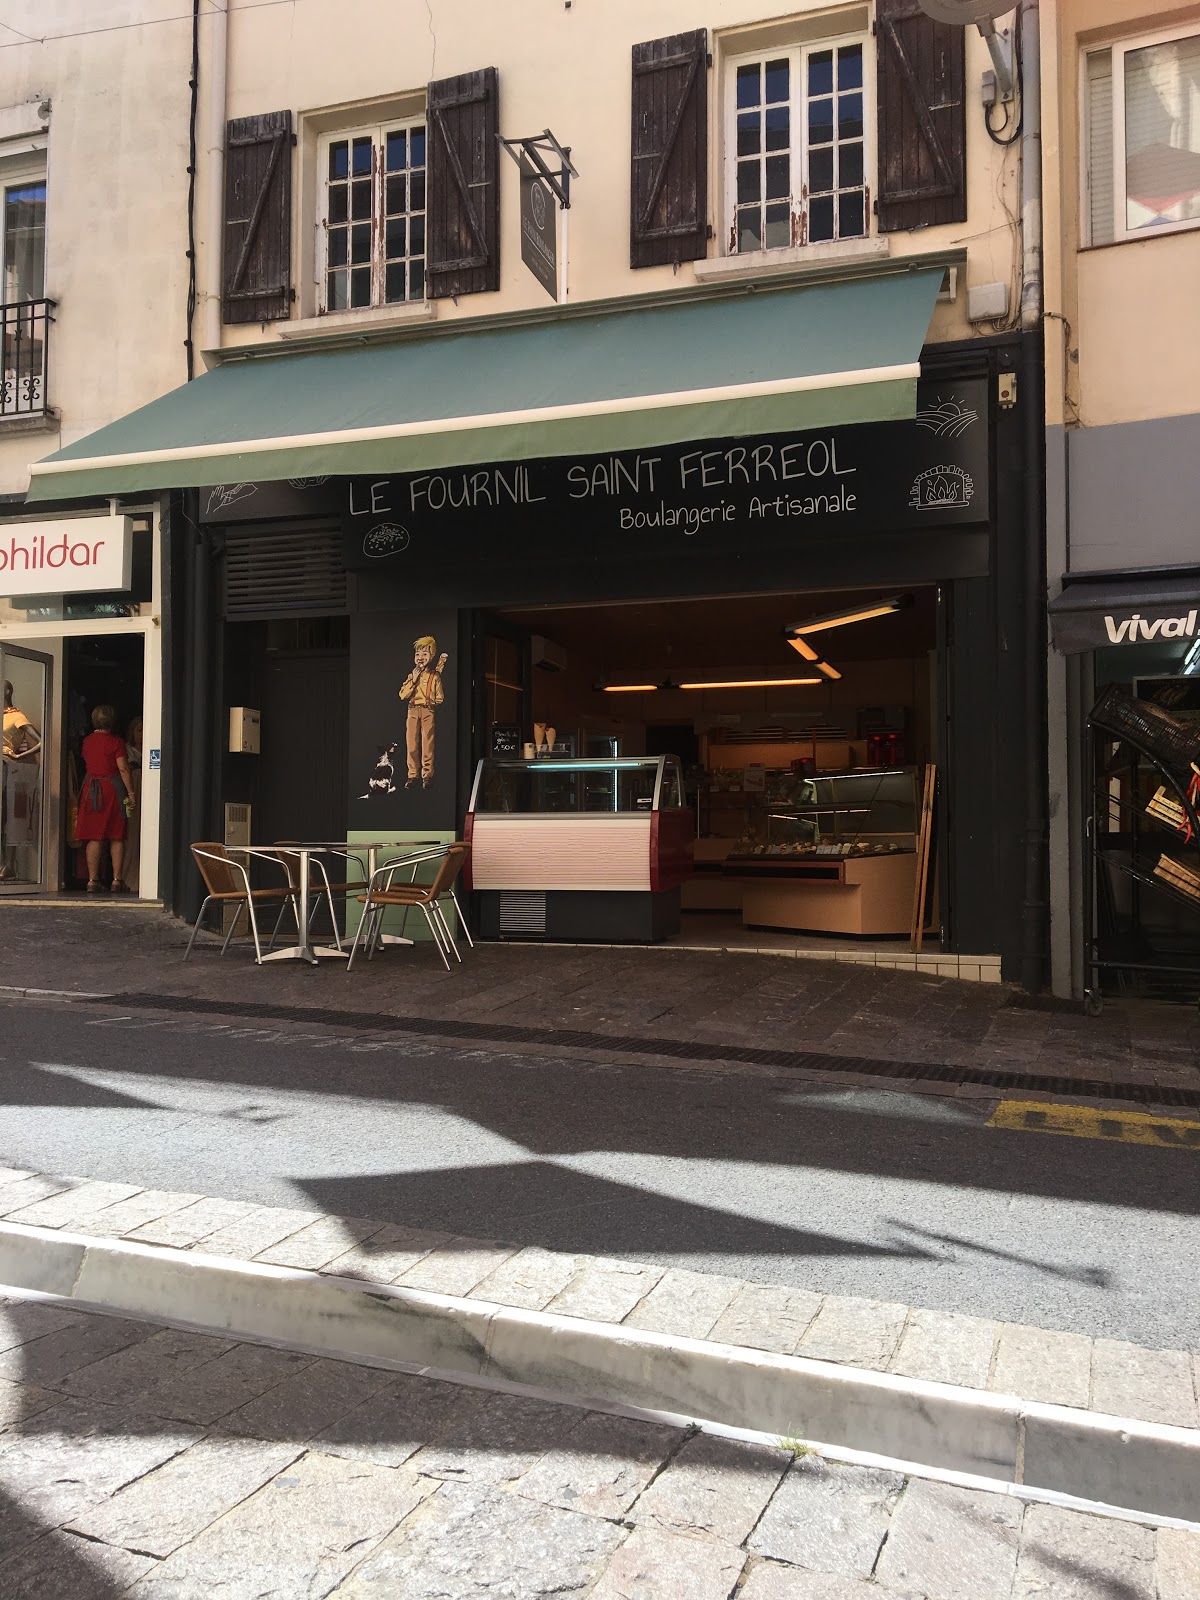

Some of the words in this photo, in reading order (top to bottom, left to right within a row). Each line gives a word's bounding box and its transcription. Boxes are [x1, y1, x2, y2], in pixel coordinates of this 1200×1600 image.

[349, 481, 392, 516] LE
[409, 465, 547, 512] FOURNIL
[567, 454, 662, 499] SAINT
[679, 438, 857, 490] FERREOL
[619, 500, 736, 535] Boulangerie
[748, 484, 857, 518] Artisanale
[1103, 609, 1198, 644] Vival
